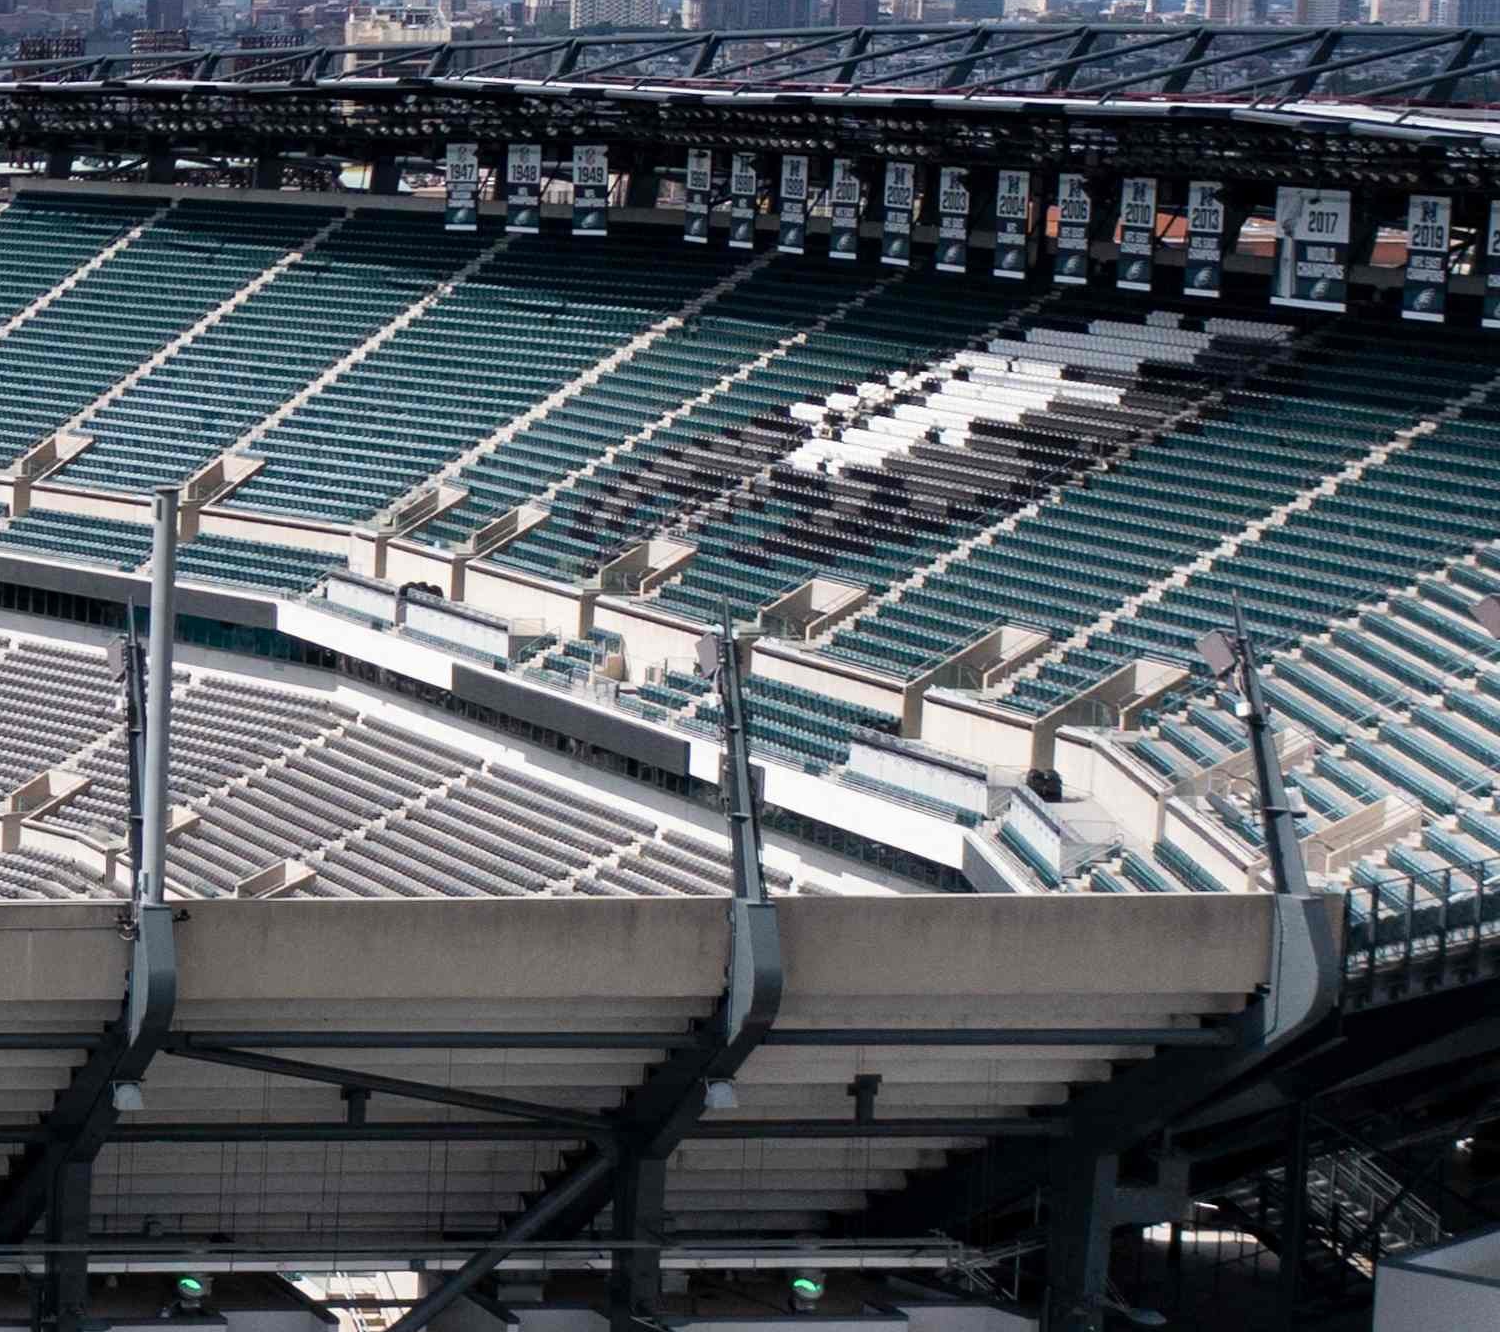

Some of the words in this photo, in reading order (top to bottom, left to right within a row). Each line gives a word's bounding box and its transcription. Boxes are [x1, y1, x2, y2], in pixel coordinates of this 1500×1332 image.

[450, 164, 474, 179] 1947
[512, 166, 537, 181] 1948
[578, 167, 604, 183] 1949
[1000, 195, 1025, 215] 2004
[1126, 203, 1150, 224] 2010
[1192, 207, 1219, 230] 2013
[1308, 211, 1339, 235] 2017
[1412, 225, 1444, 249] 2019
